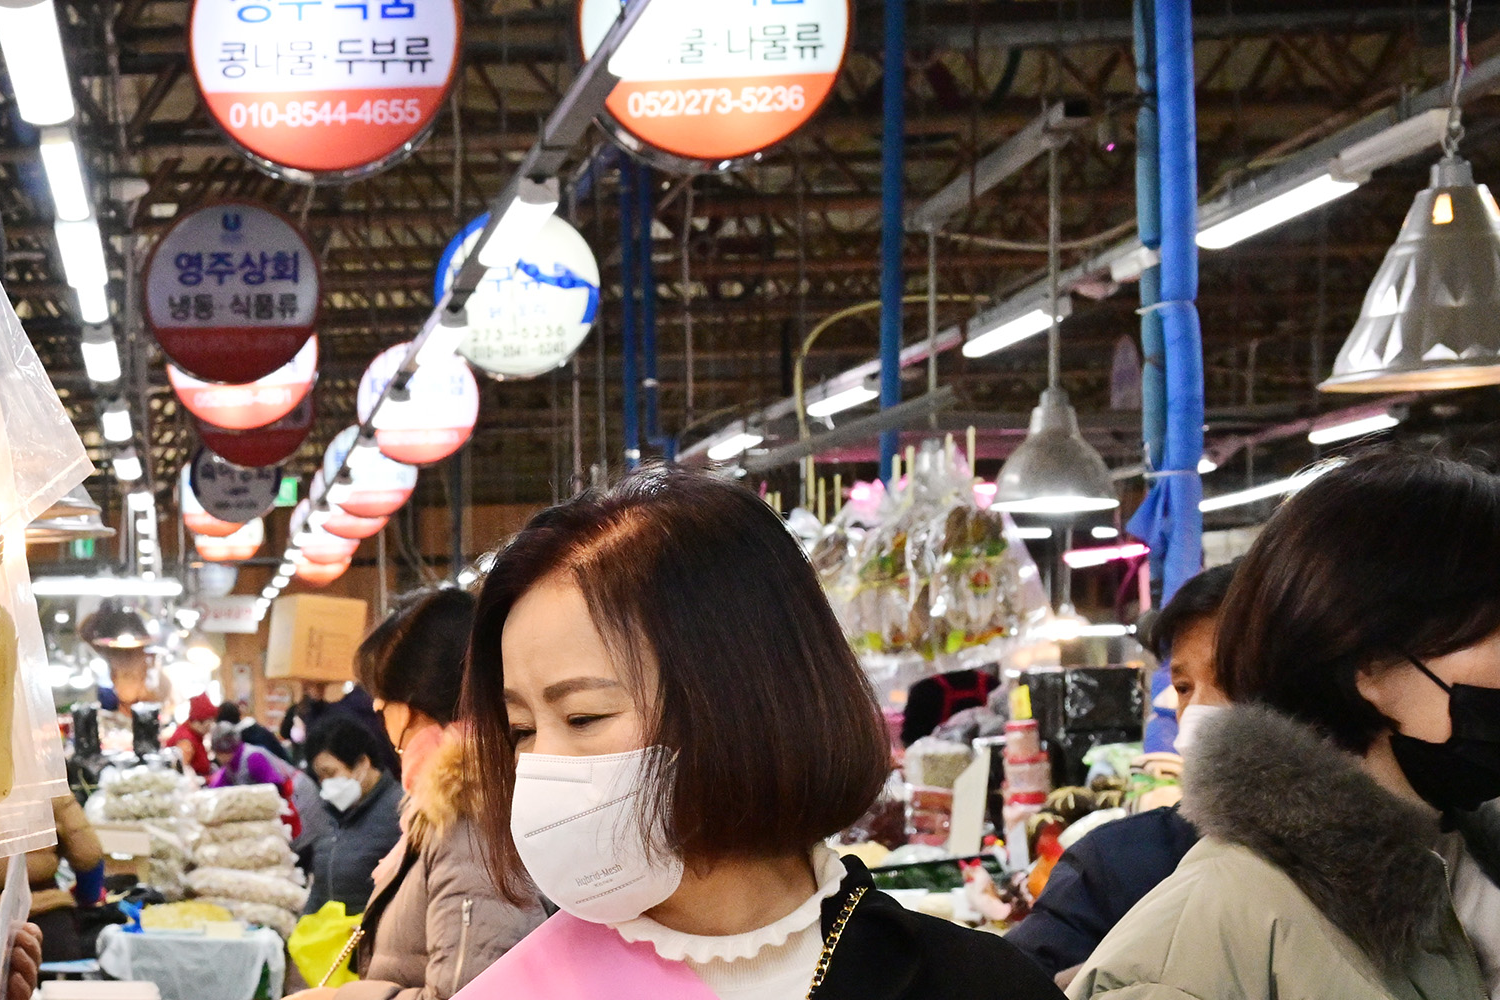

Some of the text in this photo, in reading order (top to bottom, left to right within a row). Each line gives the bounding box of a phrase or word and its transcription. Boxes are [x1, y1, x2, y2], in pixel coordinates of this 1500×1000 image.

[228, 98, 422, 129] 010-8544-4655
[626, 84, 806, 118] 052)273-5236
[174, 251, 299, 287] 영주상회
[574, 862, 624, 887] Hybrid-Mesh
